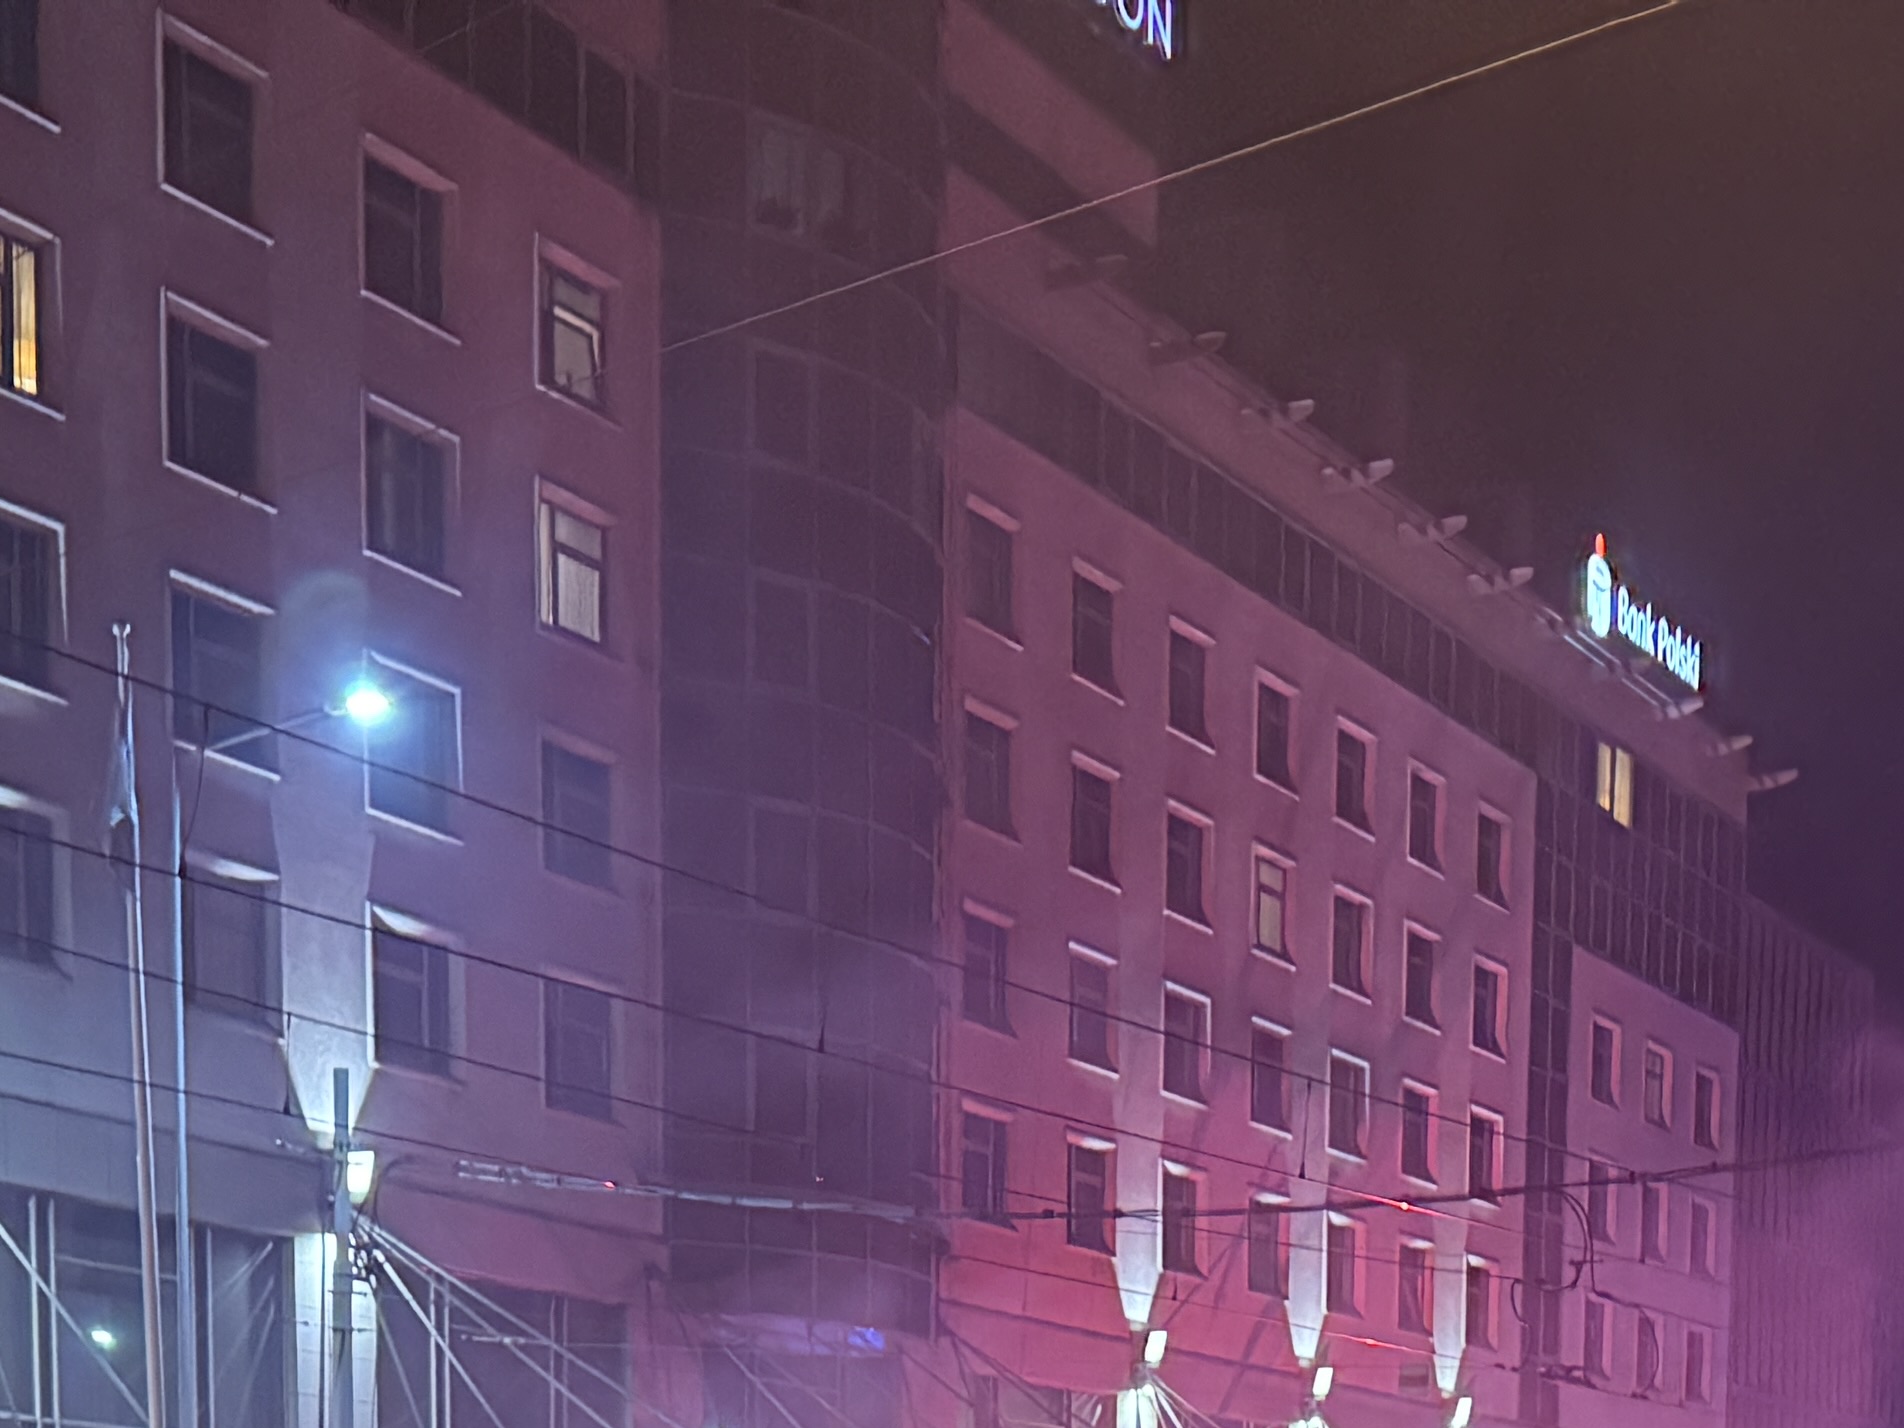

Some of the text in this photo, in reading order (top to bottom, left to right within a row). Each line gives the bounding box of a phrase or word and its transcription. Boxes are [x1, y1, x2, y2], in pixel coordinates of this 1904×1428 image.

[1096, 0, 1172, 61] ON
[1617, 584, 1701, 691] Bank Polski
